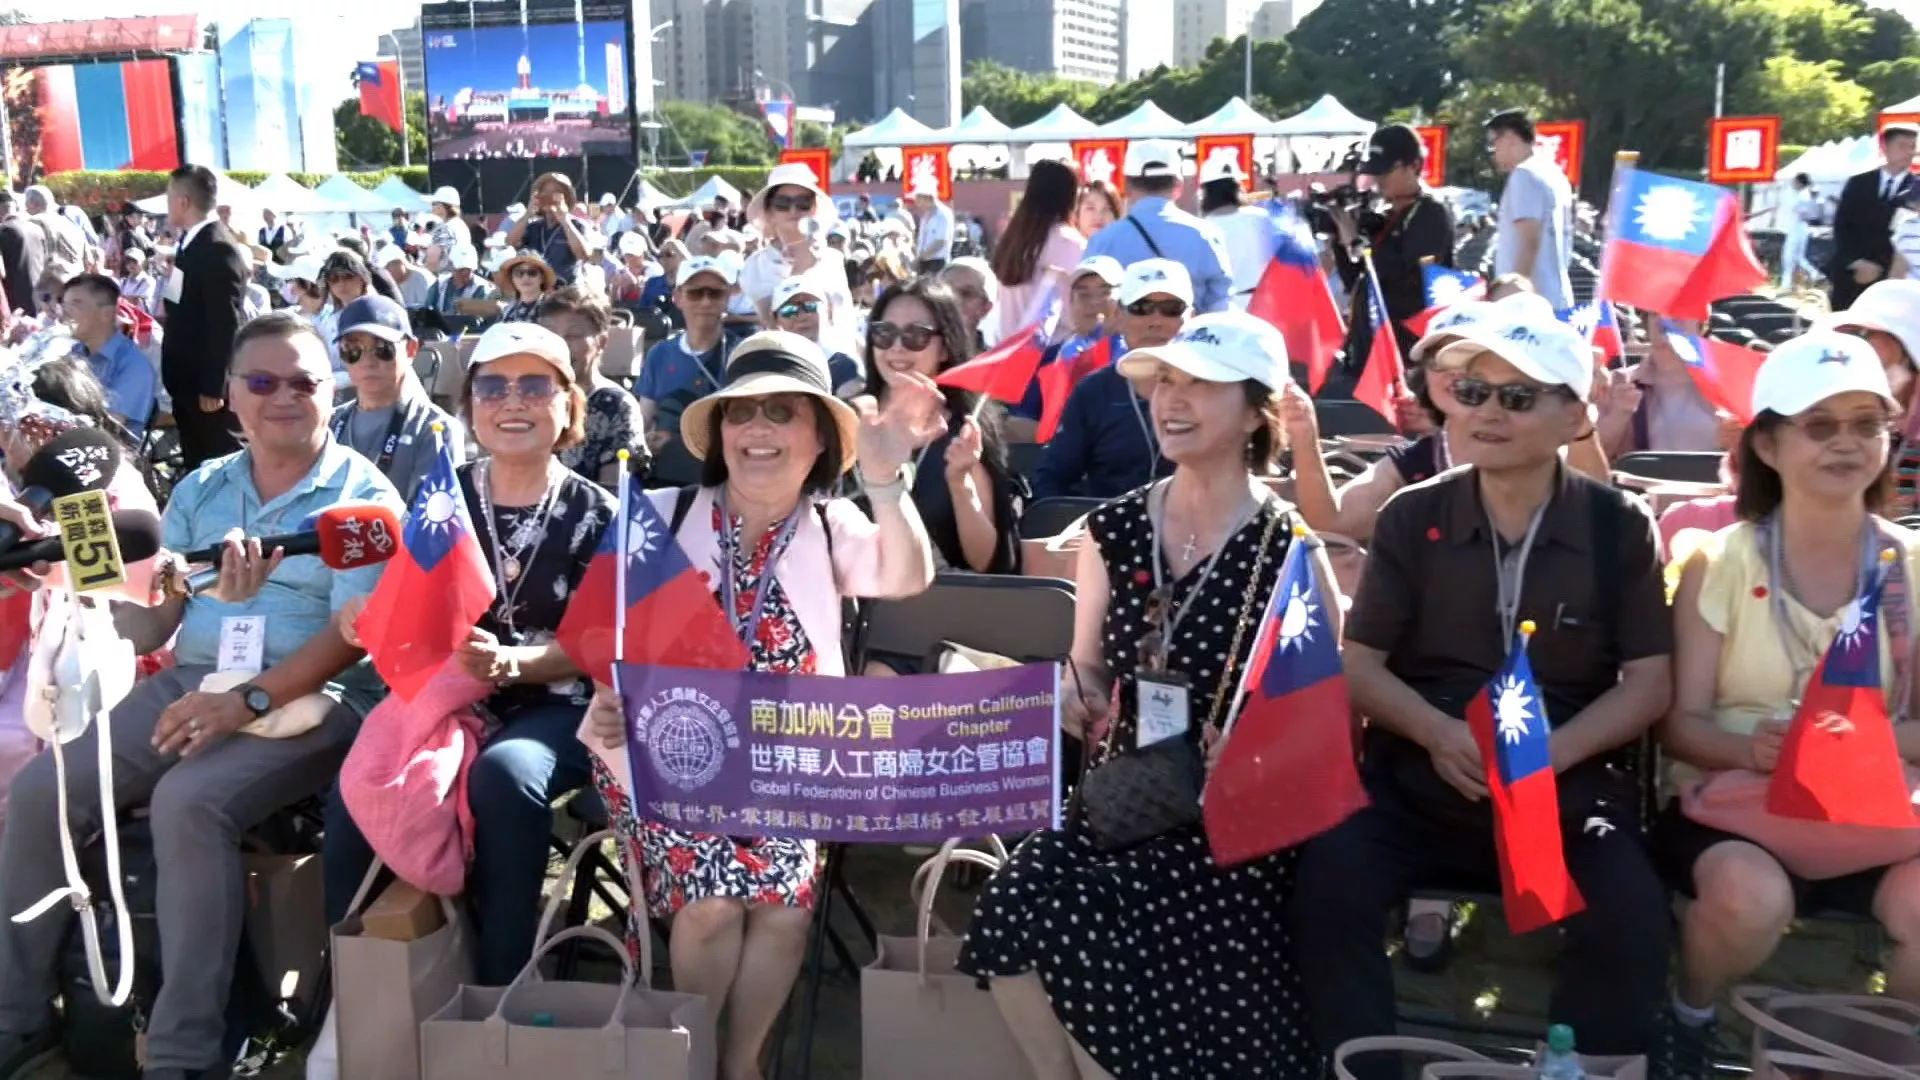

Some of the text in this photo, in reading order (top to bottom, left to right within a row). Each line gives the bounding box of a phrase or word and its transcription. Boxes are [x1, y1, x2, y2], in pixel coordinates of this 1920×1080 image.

[336, 516, 365, 563] 中視
[73, 541, 119, 585] 51
[750, 699, 896, 739] 南加州分會
[898, 691, 1055, 720] Southern California
[947, 719, 1012, 737] Chapter
[750, 736, 1049, 778] 世界華人工商婦女企管協會
[750, 774, 1050, 800] Global Federation of Chinese Business Women
